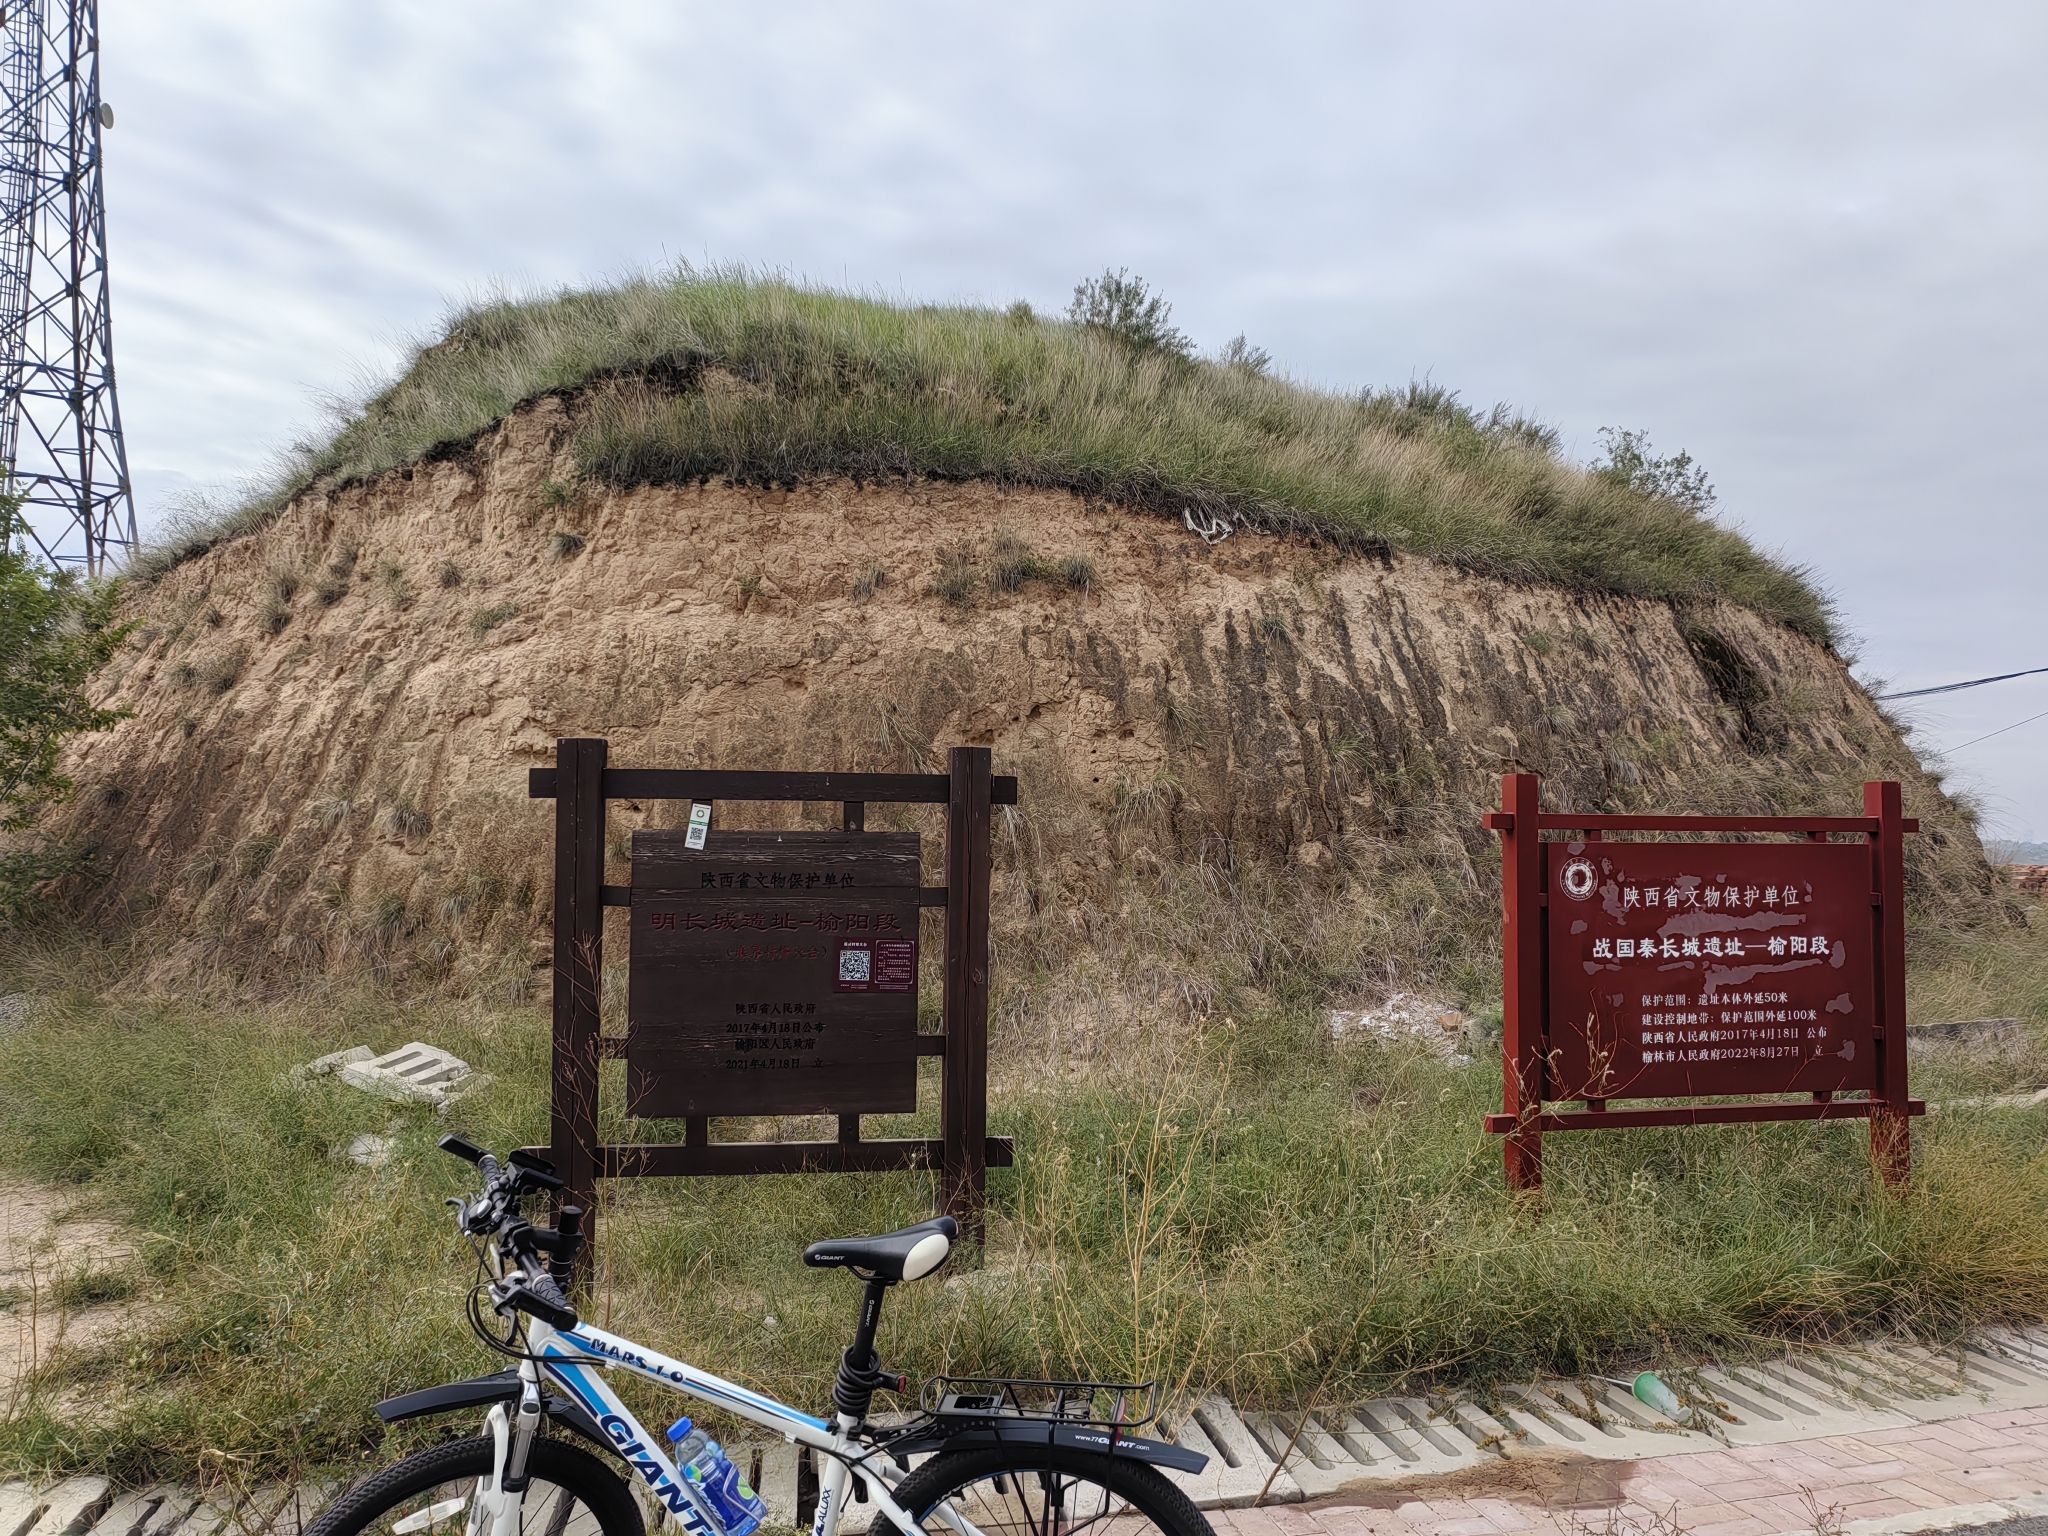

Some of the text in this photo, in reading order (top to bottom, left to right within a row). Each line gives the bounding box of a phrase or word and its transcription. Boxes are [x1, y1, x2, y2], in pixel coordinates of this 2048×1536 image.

[701, 872, 855, 889] 陕西省文物保护单位
[1623, 885, 1800, 909] 陕西省文物保护单位
[735, 1003, 816, 1014] 陕西省人民政府
[726, 1022, 824, 1034] 2017年4月18日公布
[590, 1338, 647, 1369] MARS
[600, 1413, 713, 1532] GIANT
[818, 1486, 831, 1524] ALUXX
